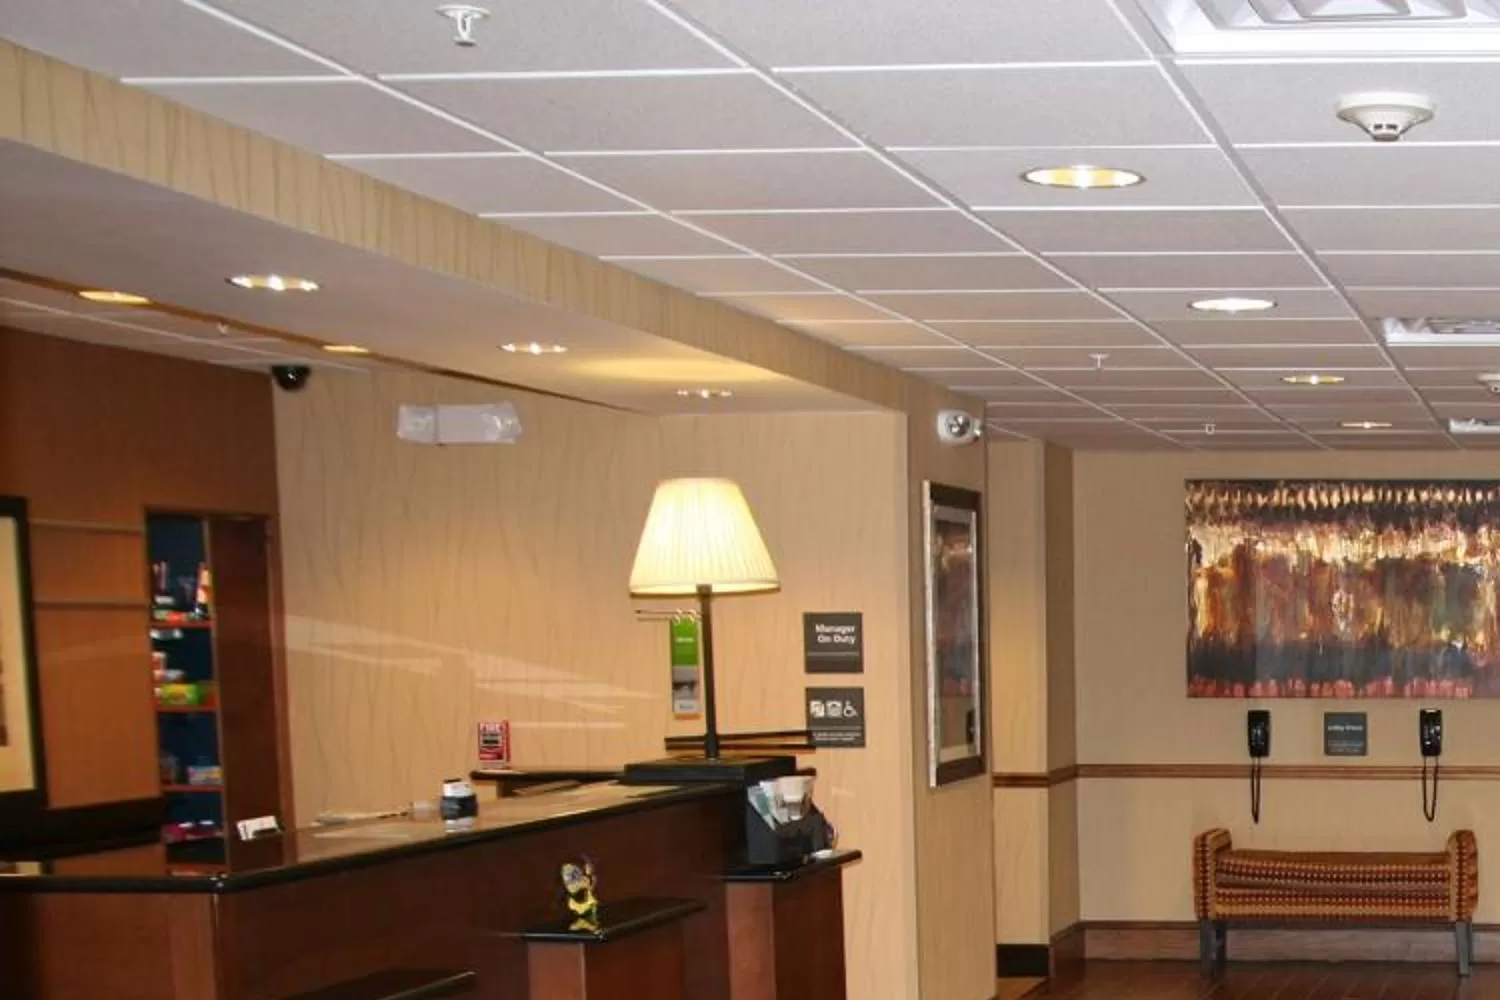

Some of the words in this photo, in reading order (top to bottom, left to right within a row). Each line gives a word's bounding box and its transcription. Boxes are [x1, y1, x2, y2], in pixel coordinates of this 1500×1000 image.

[815, 623, 856, 635] Manager
[817, 634, 832, 643] On
[833, 634, 856, 645] Duty
